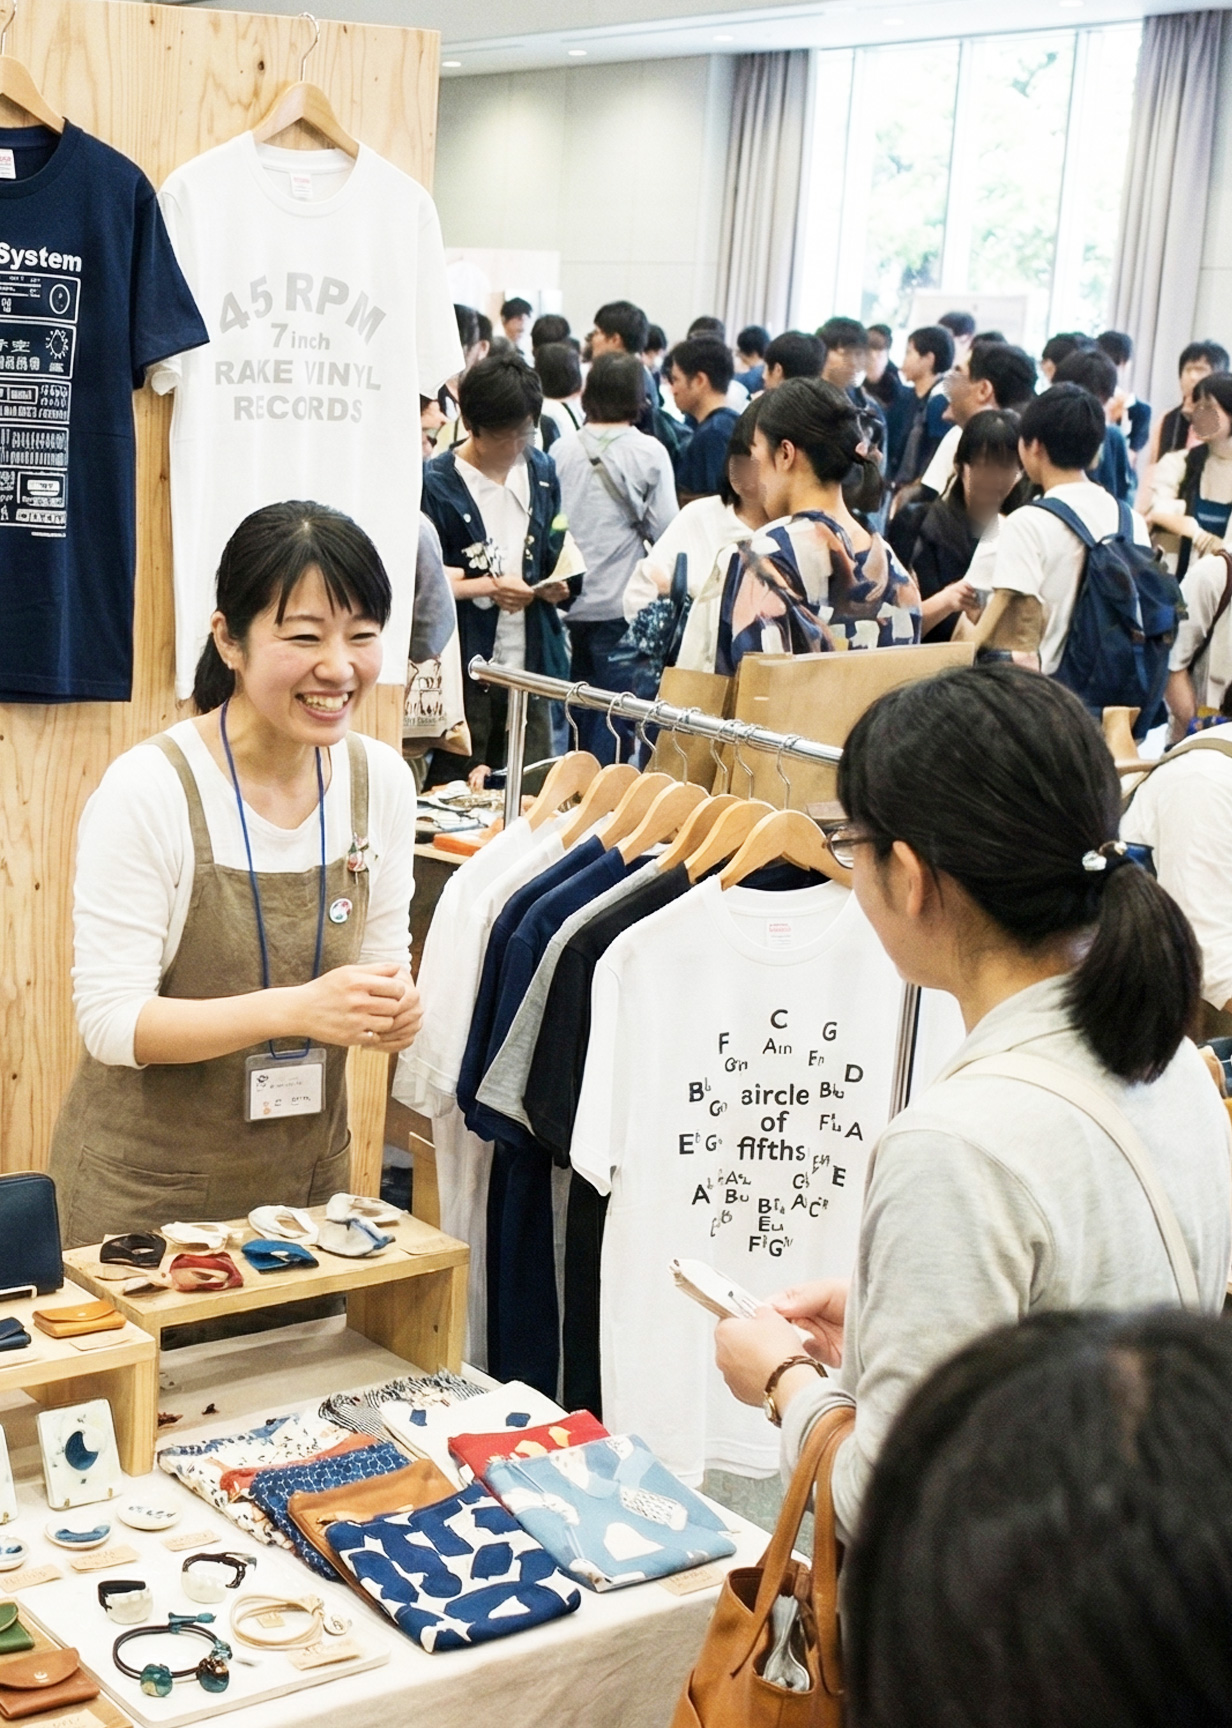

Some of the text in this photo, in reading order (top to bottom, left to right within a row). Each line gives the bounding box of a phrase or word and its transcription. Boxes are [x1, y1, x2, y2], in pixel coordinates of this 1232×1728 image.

[219, 271, 387, 345] 45 RPM
[270, 322, 331, 350] 7 inch
[215, 359, 382, 391] RAKE VINYL
[233, 395, 363, 424] RECORDS
[770, 1009, 788, 1029] C
[822, 1021, 838, 1041] G
[718, 1032, 730, 1054] F
[844, 1063, 864, 1083] D
[760, 1110, 790, 1133] of
[844, 1121, 863, 1141] A
